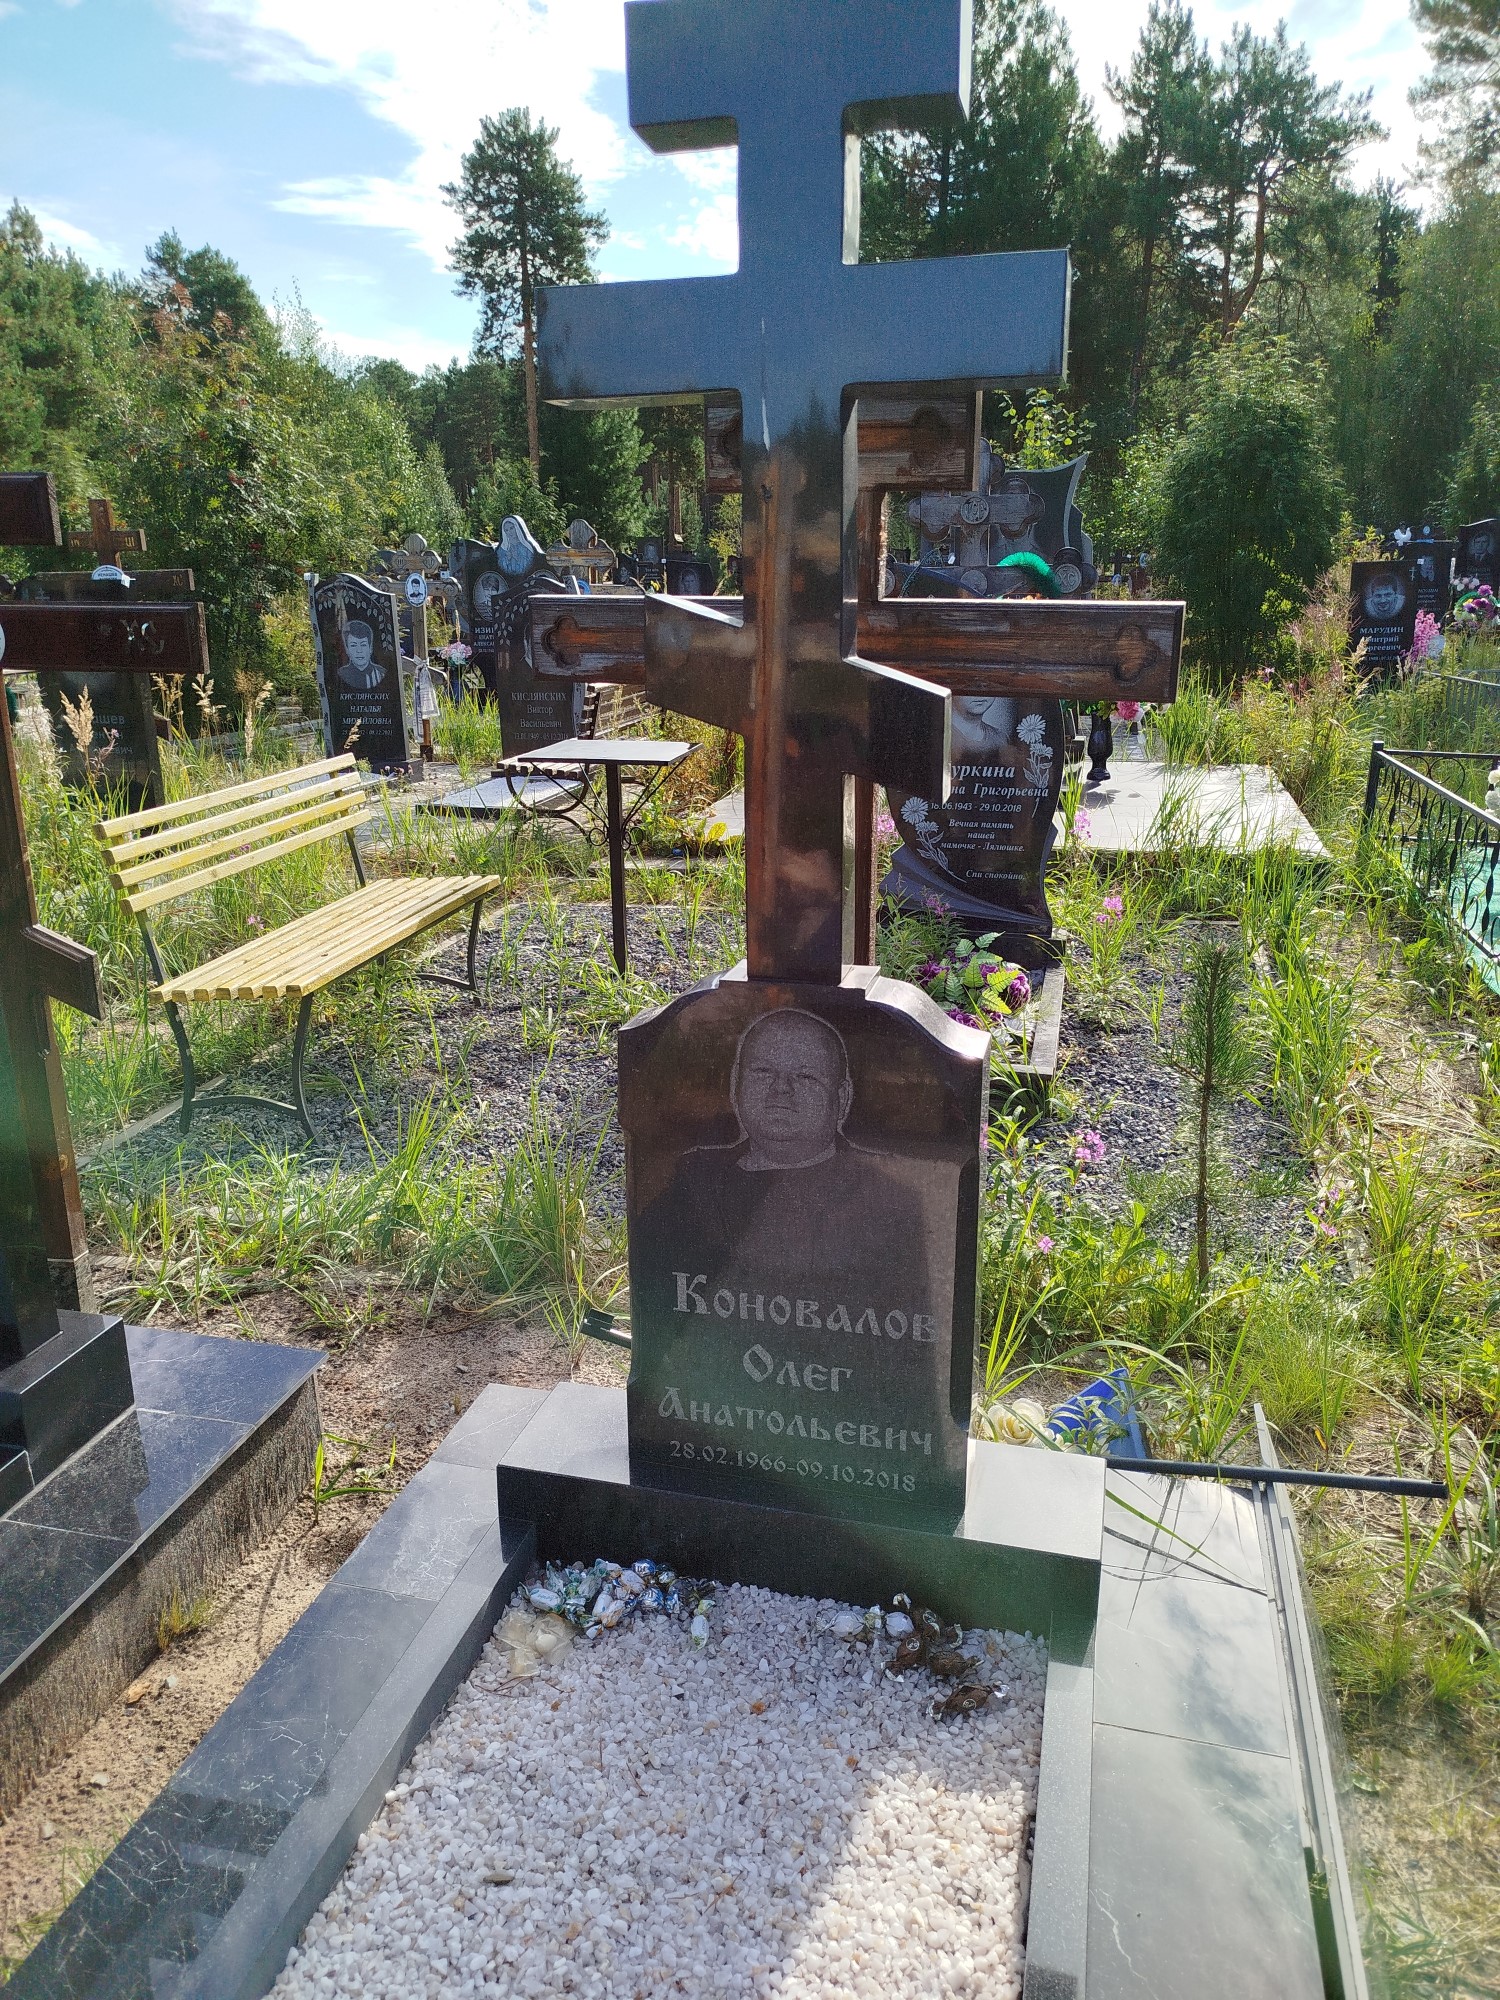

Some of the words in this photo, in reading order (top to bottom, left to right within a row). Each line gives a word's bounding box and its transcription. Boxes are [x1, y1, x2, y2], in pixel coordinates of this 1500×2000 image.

[1359, 626, 1404, 634] МАРУДИН
[340, 692, 391, 700] КИСЛЯНСКИХ
[511, 692, 567, 701] КИСЛЯНСКИХ
[350, 705, 382, 713] НАТАЛЬЯ
[527, 704, 554, 717] Виктор
[520, 718, 562, 728] Васильевич
[972, 783, 1049, 799] Григорьевна
[979, 803, 1022, 813] 29.10.2018
[948, 818, 979, 828] Вечная
[980, 821, 1014, 830] память
[967, 831, 995, 840] нашей
[940, 842, 976, 850] мамочке
[982, 841, 1025, 852] Лялюшке.
[965, 869, 983, 878] Спи
[984, 871, 1025, 881] спокойно.
[671, 1271, 939, 1343] Коновалов
[741, 1343, 854, 1392] Олег
[657, 1386, 933, 1456] Анатольевич
[668, 1439, 917, 1493] 28.02.1966-09.10.2018
